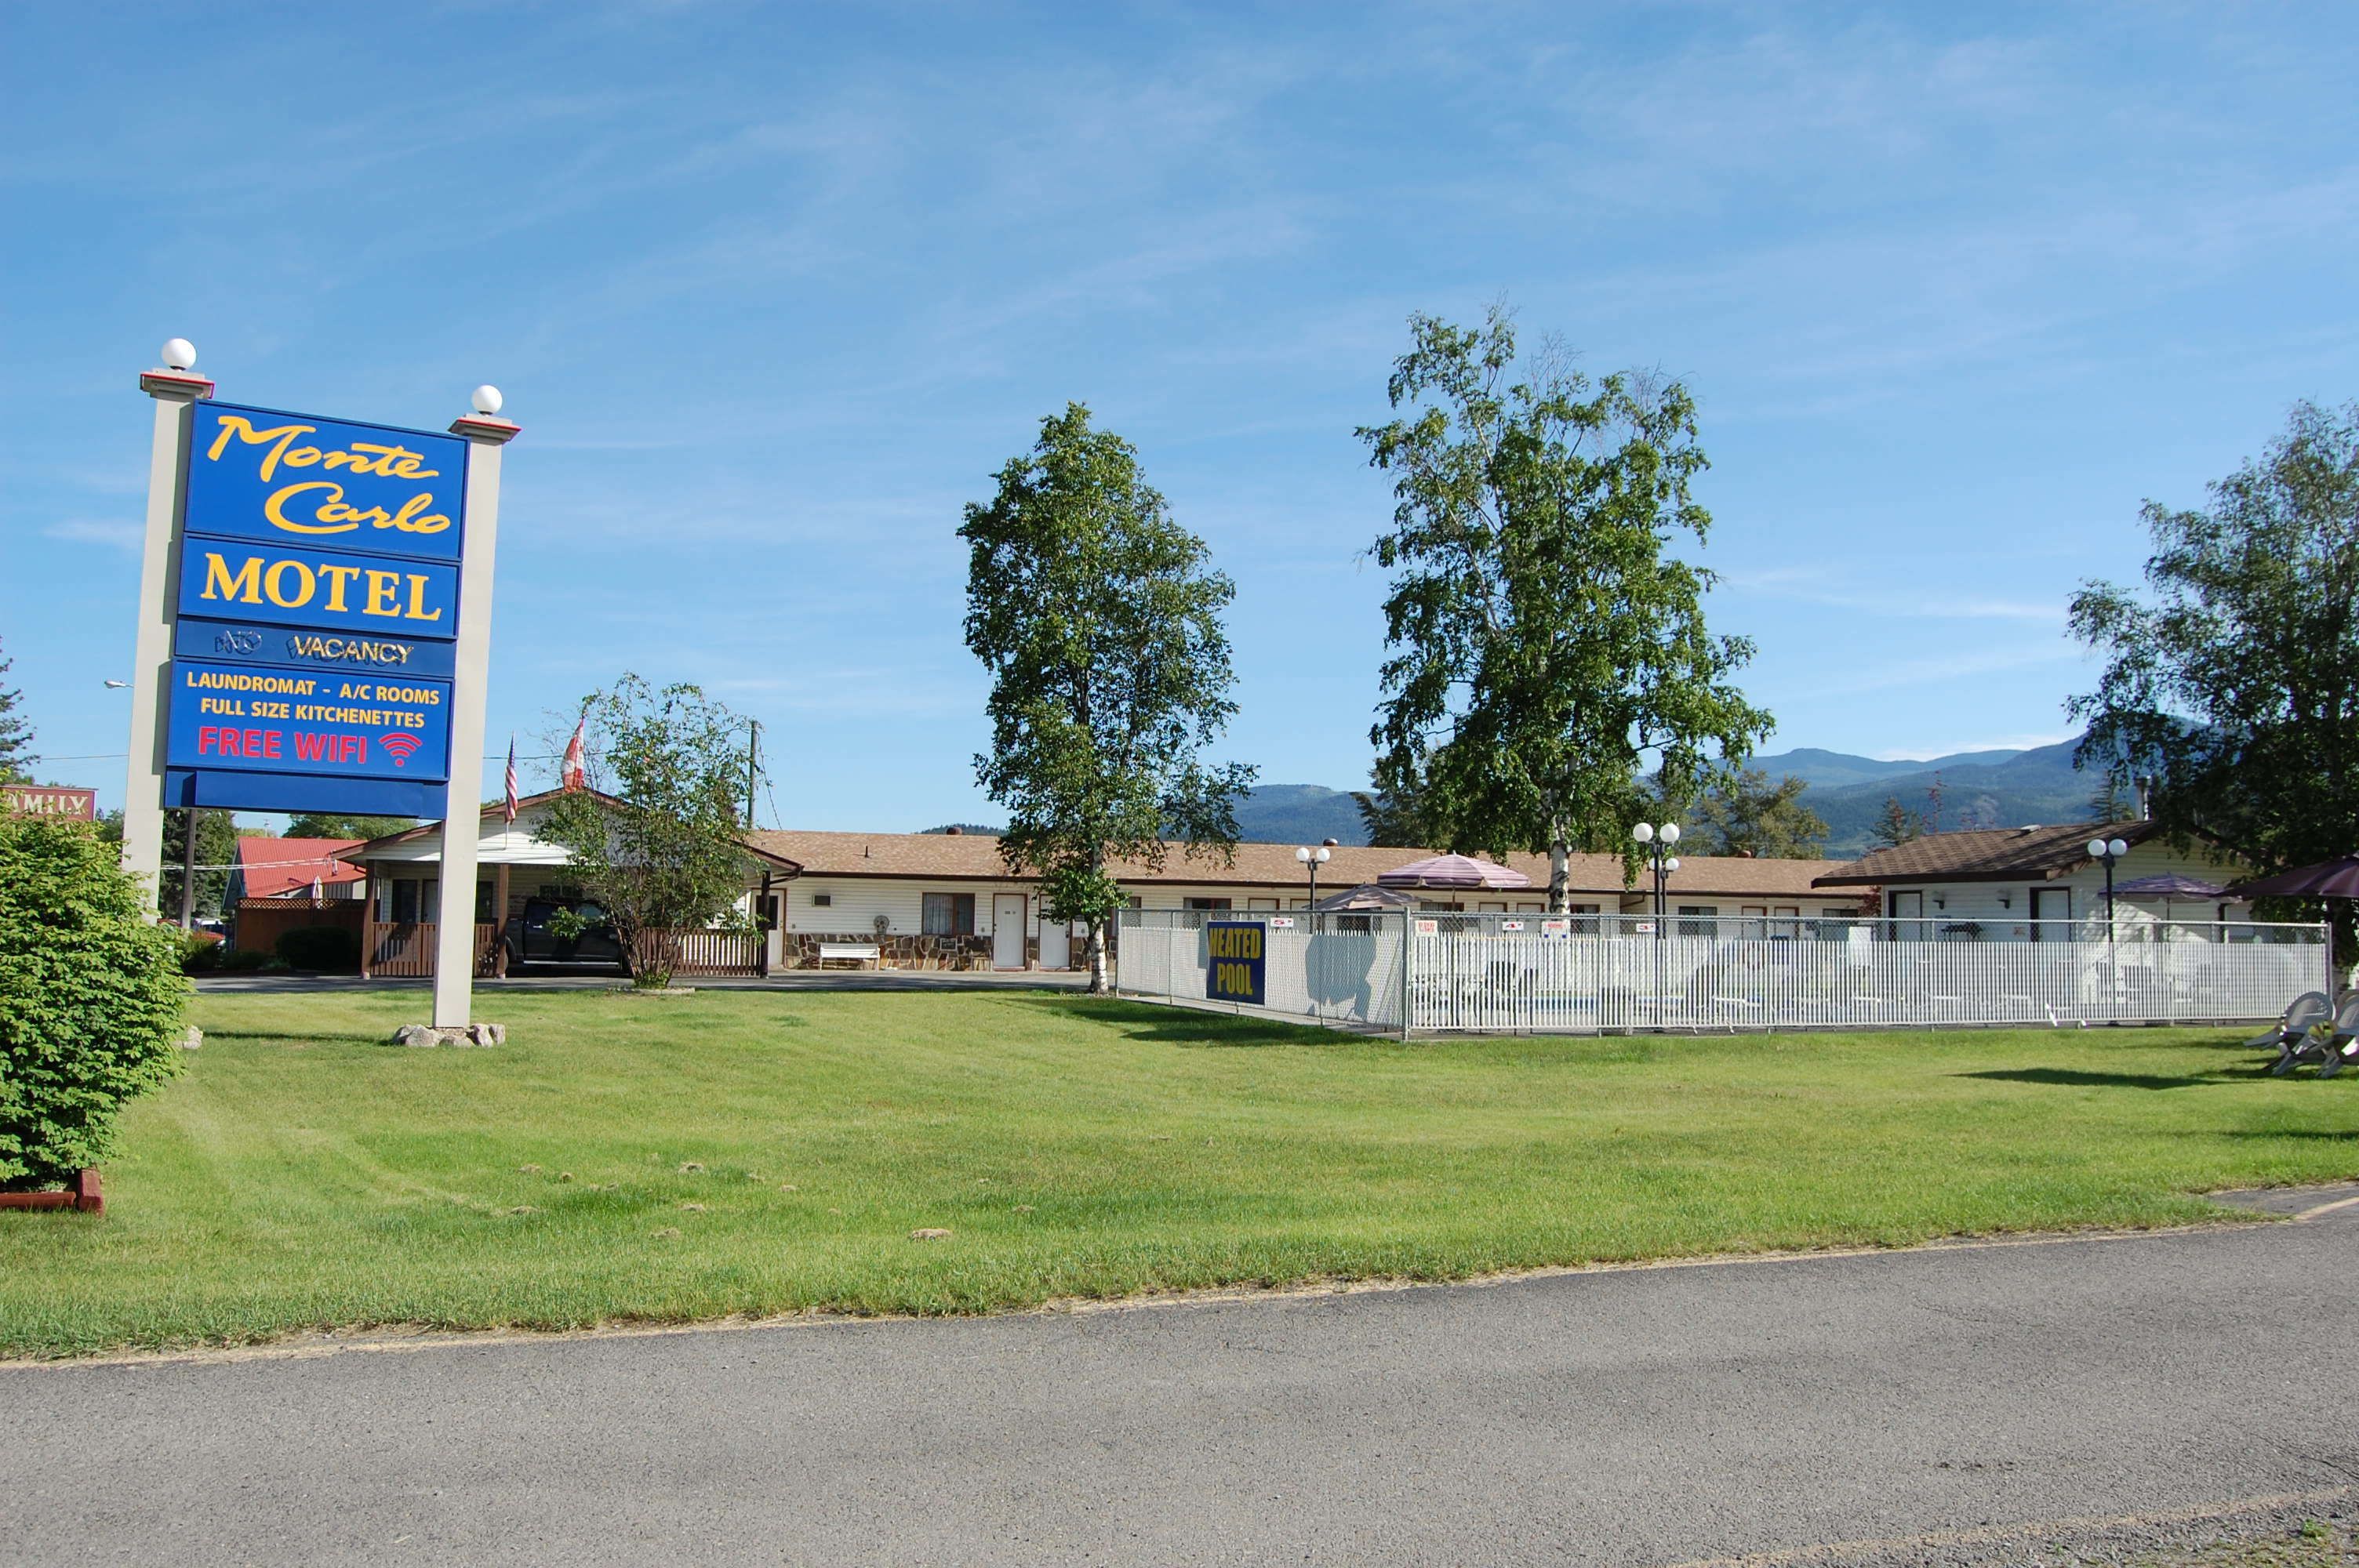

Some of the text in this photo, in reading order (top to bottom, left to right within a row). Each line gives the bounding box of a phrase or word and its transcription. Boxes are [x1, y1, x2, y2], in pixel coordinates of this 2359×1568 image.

[207, 416, 439, 483] Monte
[264, 481, 451, 534] Carlo
[200, 553, 442, 620] MOTEL
[293, 635, 414, 664] VACANCY
[187, 671, 316, 696] LAUNDROMAT
[340, 682, 372, 702] A/C
[376, 687, 440, 706] ROOMS
[201, 698, 425, 728] FULL SIZE KITCHENETTES
[198, 726, 367, 764] FREE WIFI
[5, 792, 89, 815] AMILY
[1209, 927, 1260, 960] HEATED
[1217, 963, 1252, 996] POOL
